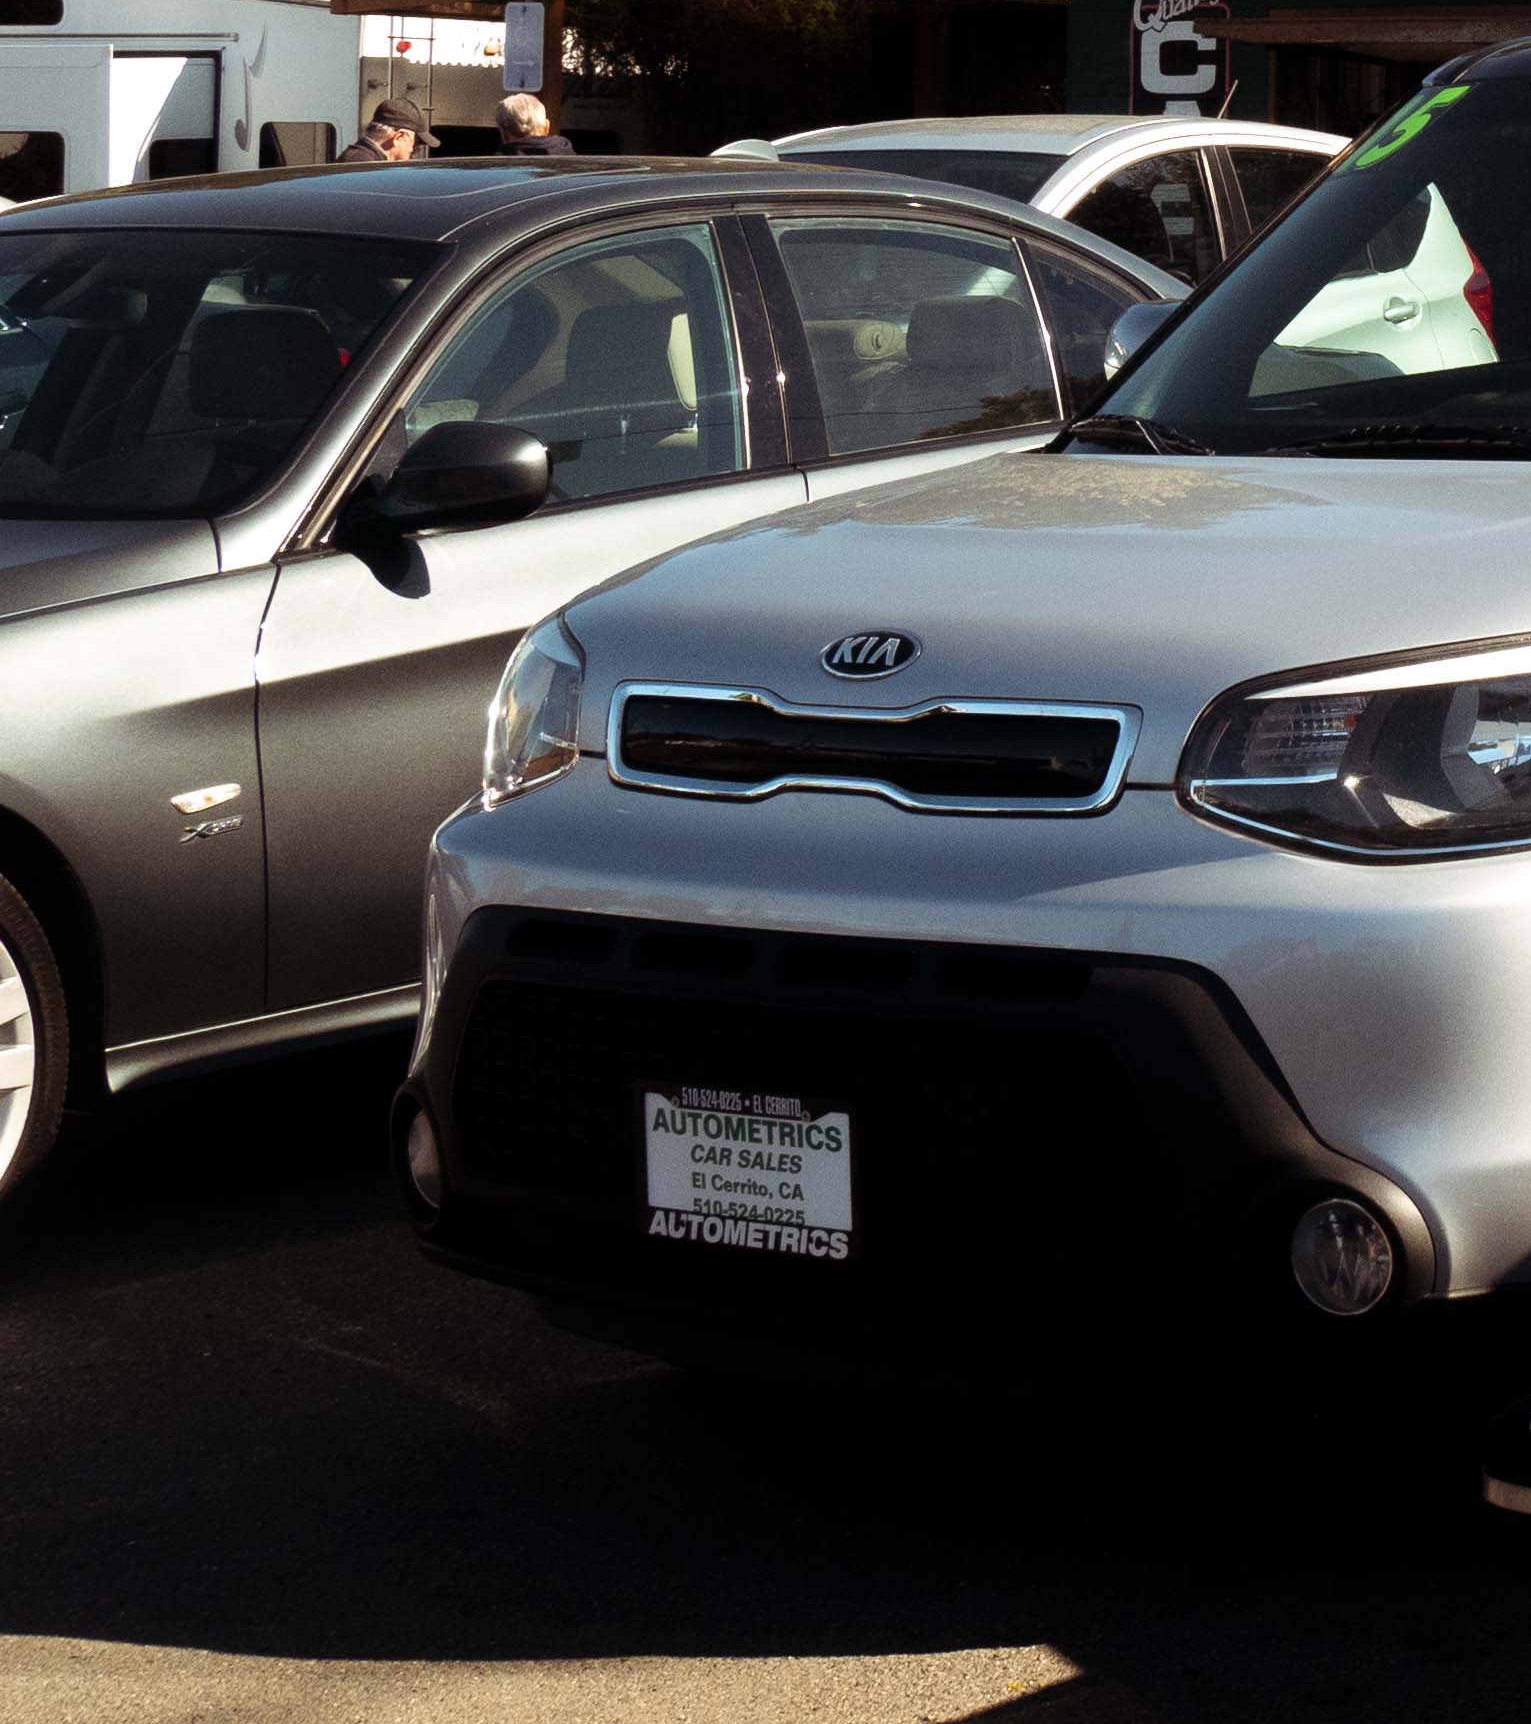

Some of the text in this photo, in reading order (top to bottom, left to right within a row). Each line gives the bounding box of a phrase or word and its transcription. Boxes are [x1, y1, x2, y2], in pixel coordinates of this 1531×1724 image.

[832, 636, 901, 666] KIA
[682, 1086, 742, 1112] 510-524-0225
[652, 1107, 842, 1153] AUTOMETRICS
[690, 1144, 803, 1174] CAR SALES
[691, 1172, 804, 1201] El Cerrito, CA
[648, 1209, 850, 1260] AUTOMETRICS
